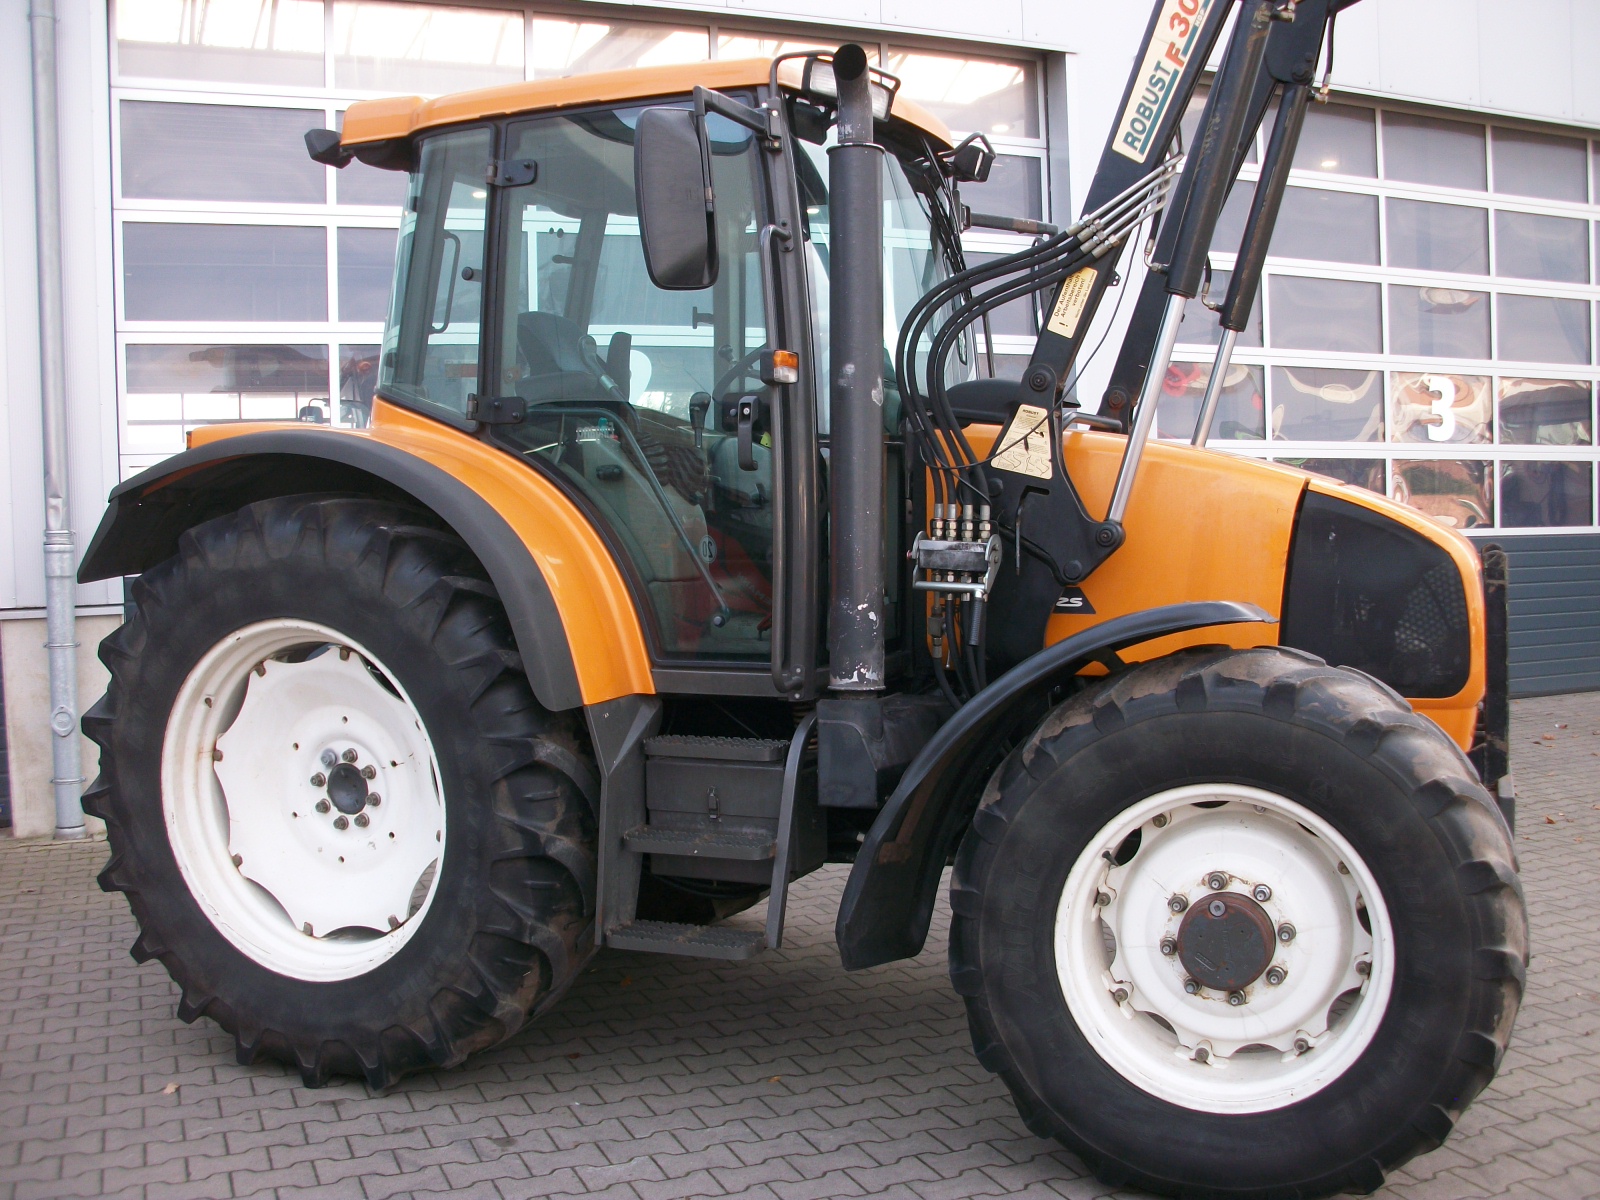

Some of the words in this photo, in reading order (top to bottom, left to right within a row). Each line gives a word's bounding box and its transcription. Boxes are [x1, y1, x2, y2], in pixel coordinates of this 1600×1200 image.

[1122, 60, 1170, 151] ROBUST
[1165, 41, 1187, 69] F
[1427, 375, 1456, 441] 3
